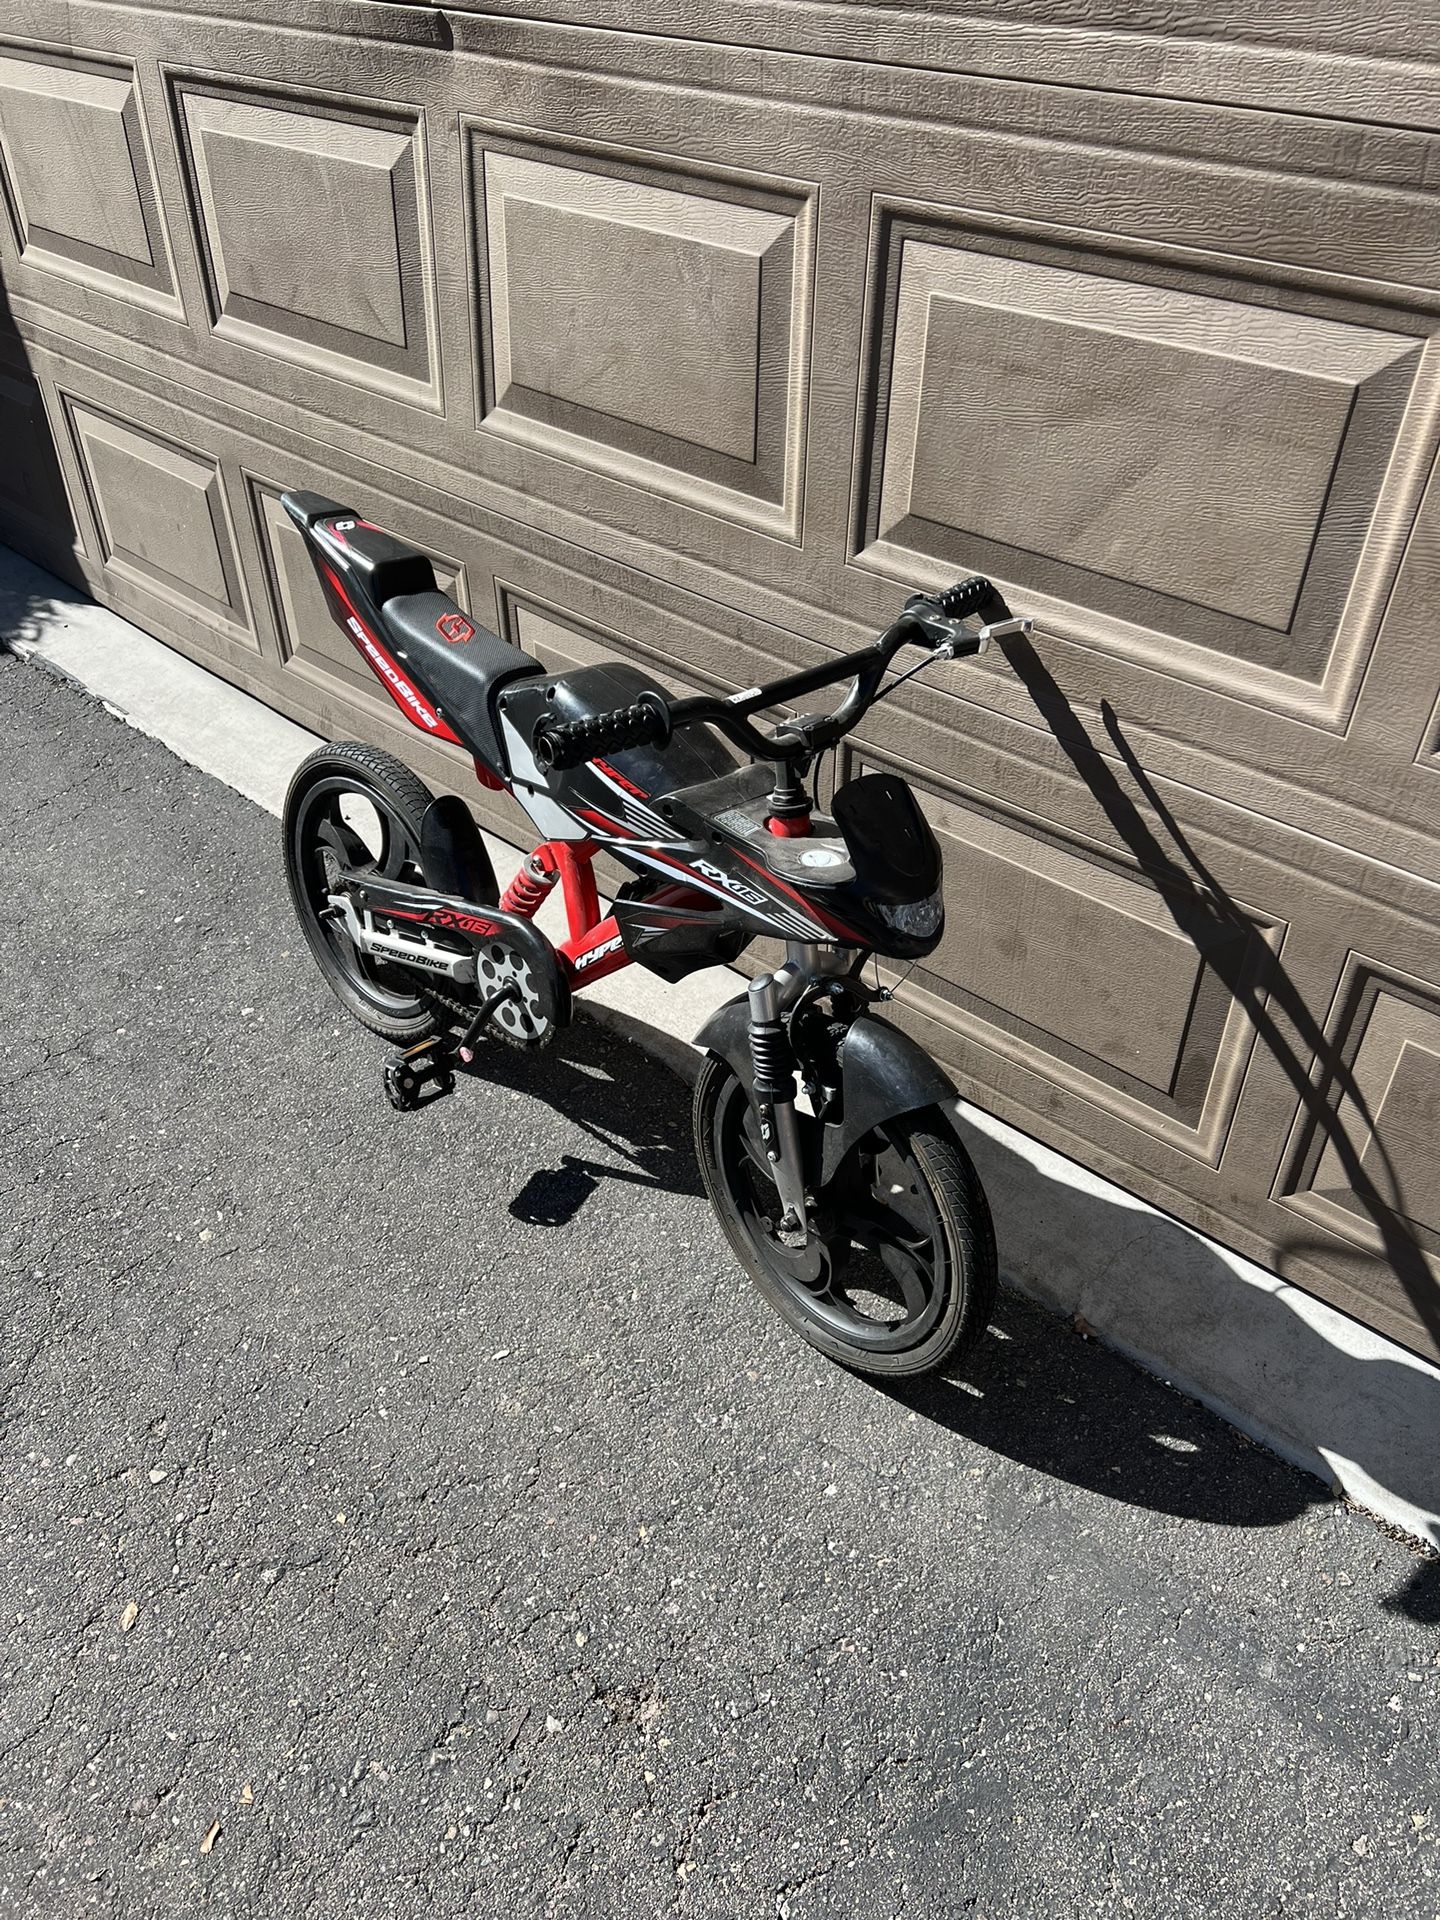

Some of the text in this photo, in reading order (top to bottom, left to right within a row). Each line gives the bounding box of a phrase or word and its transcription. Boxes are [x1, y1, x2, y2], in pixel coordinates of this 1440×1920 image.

[689, 859, 768, 905] RX16
[423, 910, 492, 936] RX16
[575, 935, 624, 970] HYPE
